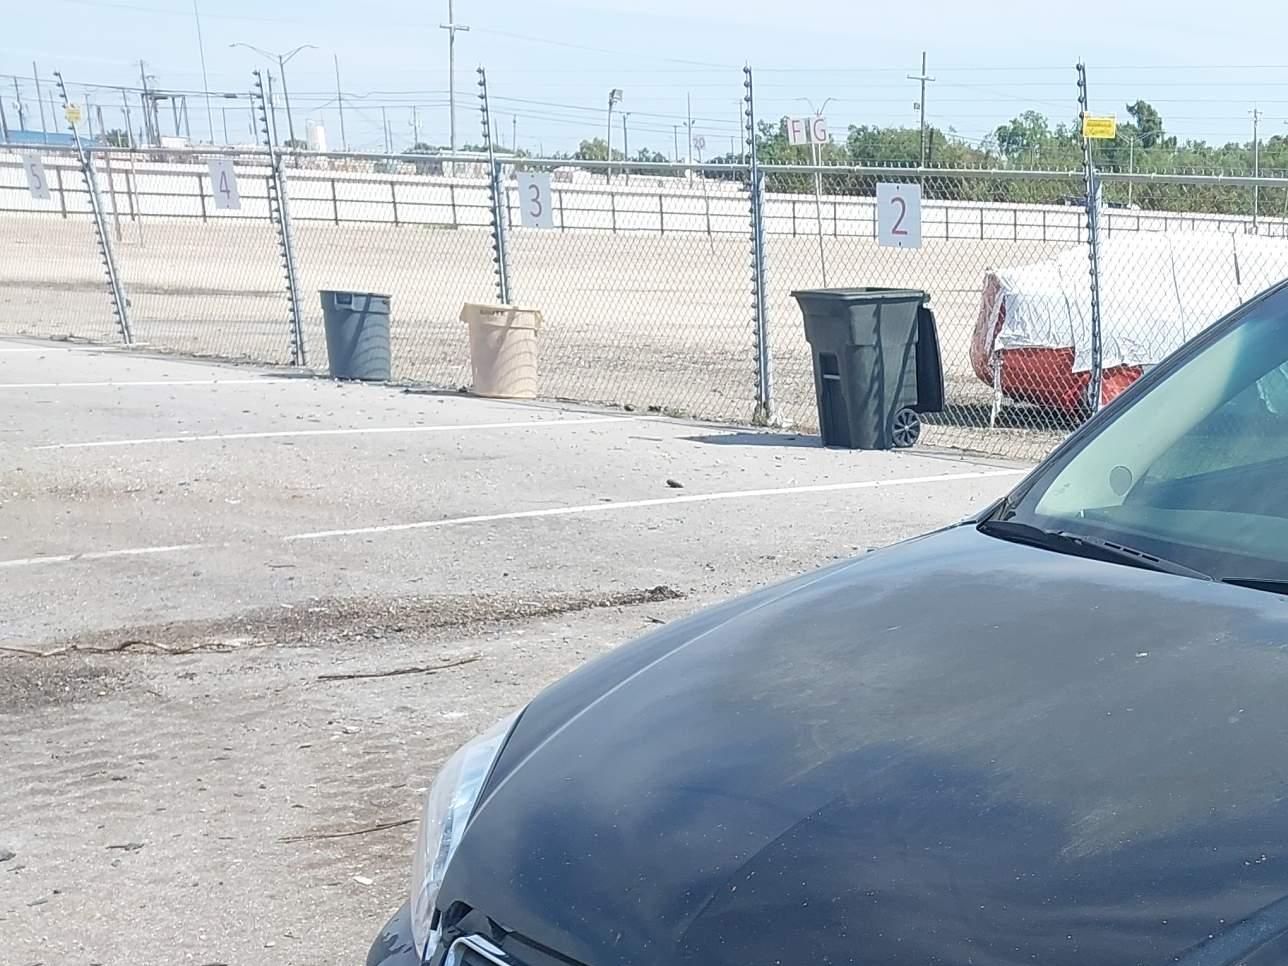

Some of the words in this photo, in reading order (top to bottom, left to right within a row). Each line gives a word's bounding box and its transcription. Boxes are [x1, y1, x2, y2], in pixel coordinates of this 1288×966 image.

[791, 120, 801, 143] F
[813, 118, 827, 142] G
[31, 163, 42, 189] 5
[219, 171, 231, 199] 4
[528, 184, 542, 217] 3
[891, 197, 908, 235] 2
